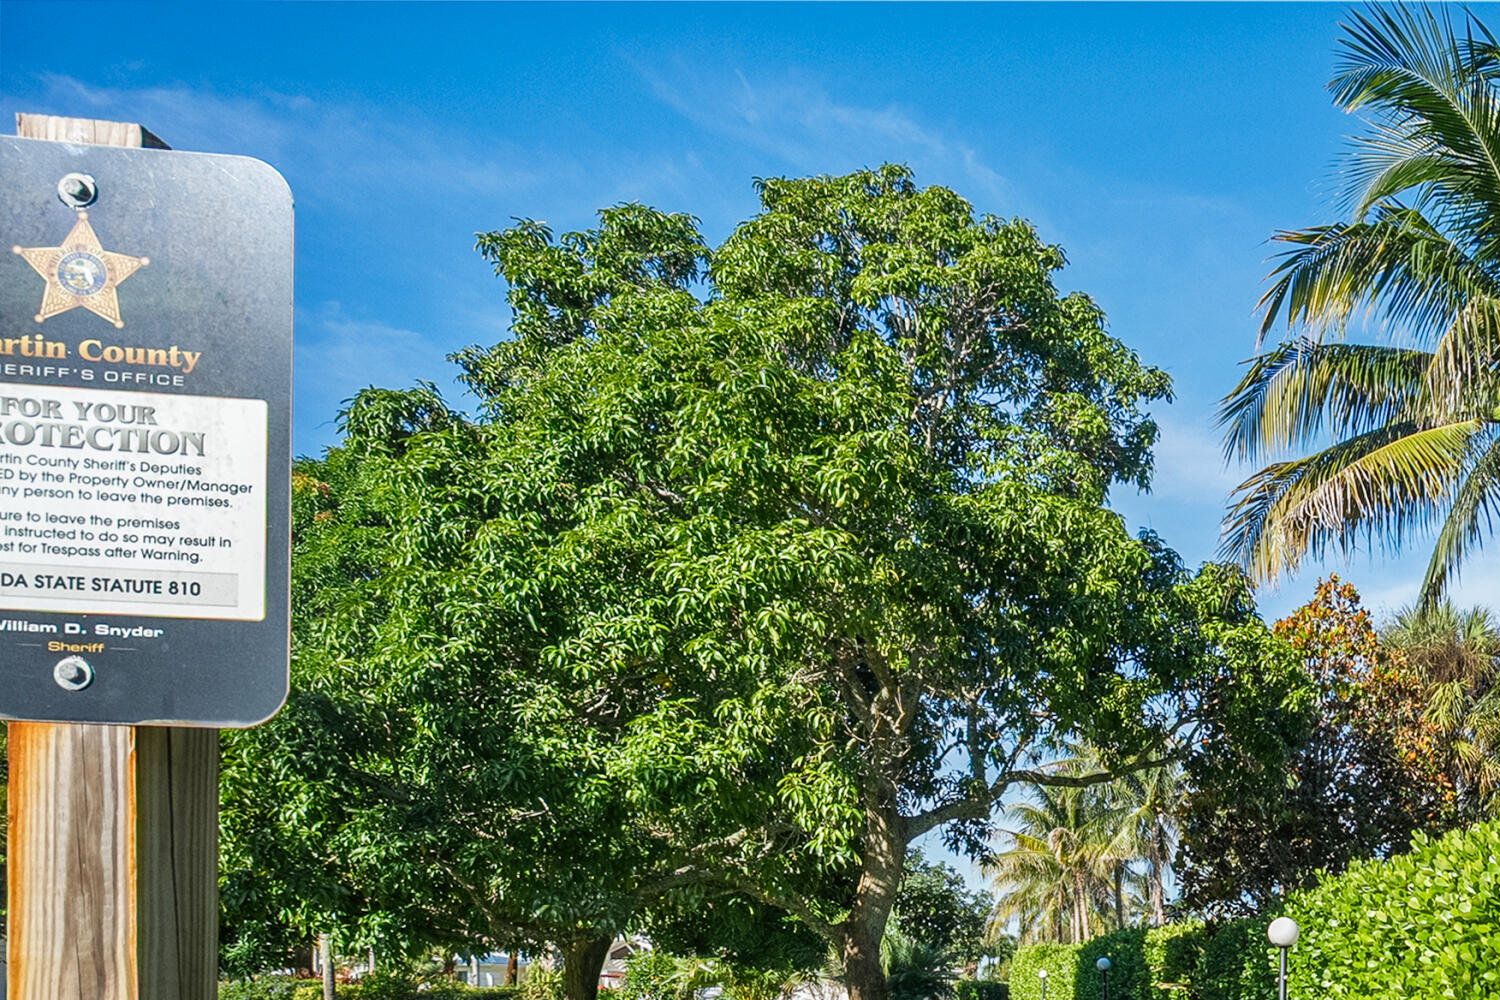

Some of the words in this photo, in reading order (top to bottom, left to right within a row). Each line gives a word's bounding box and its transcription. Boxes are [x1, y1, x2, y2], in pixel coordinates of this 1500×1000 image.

[79, 339, 202, 373] County
[0, 363, 95, 380] ERIFF'S
[103, 370, 185, 387] OFFICE
[0, 396, 64, 420] FOR
[72, 400, 158, 426] YOUR
[0, 420, 206, 457] OTECTION
[26, 454, 80, 470] County
[83, 457, 137, 473] Sheriff's
[140, 461, 202, 476] Deputies
[19, 469, 38, 484] by
[42, 471, 65, 483] the
[69, 472, 129, 489] Property
[133, 476, 253, 496] Owner/Manager
[23, 487, 74, 499] person
[78, 489, 93, 501] to
[96, 490, 136, 502] leave
[141, 492, 163, 504] the
[167, 494, 234, 508] premises.
[26, 511, 41, 523] to
[45, 512, 86, 525] leave
[90, 514, 113, 527] the
[117, 517, 181, 530] premises
[5, 525, 76, 540] instructed
[80, 529, 95, 541] to
[98, 531, 119, 542] do
[122, 533, 139, 543] so
[143, 534, 176, 547] may
[179, 536, 216, 547] result
[219, 536, 232, 548] in
[18, 541, 38, 553] for
[41, 542, 101, 557] Trespass
[104, 546, 138, 559] after
[140, 548, 204, 564] Warning.
[34, 574, 86, 591] STATE
[91, 577, 163, 595] STATUTE
[168, 581, 201, 596] 810
[64, 622, 87, 635] D.
[94, 623, 165, 639] Snyder
[47, 641, 105, 653] Sheriff
